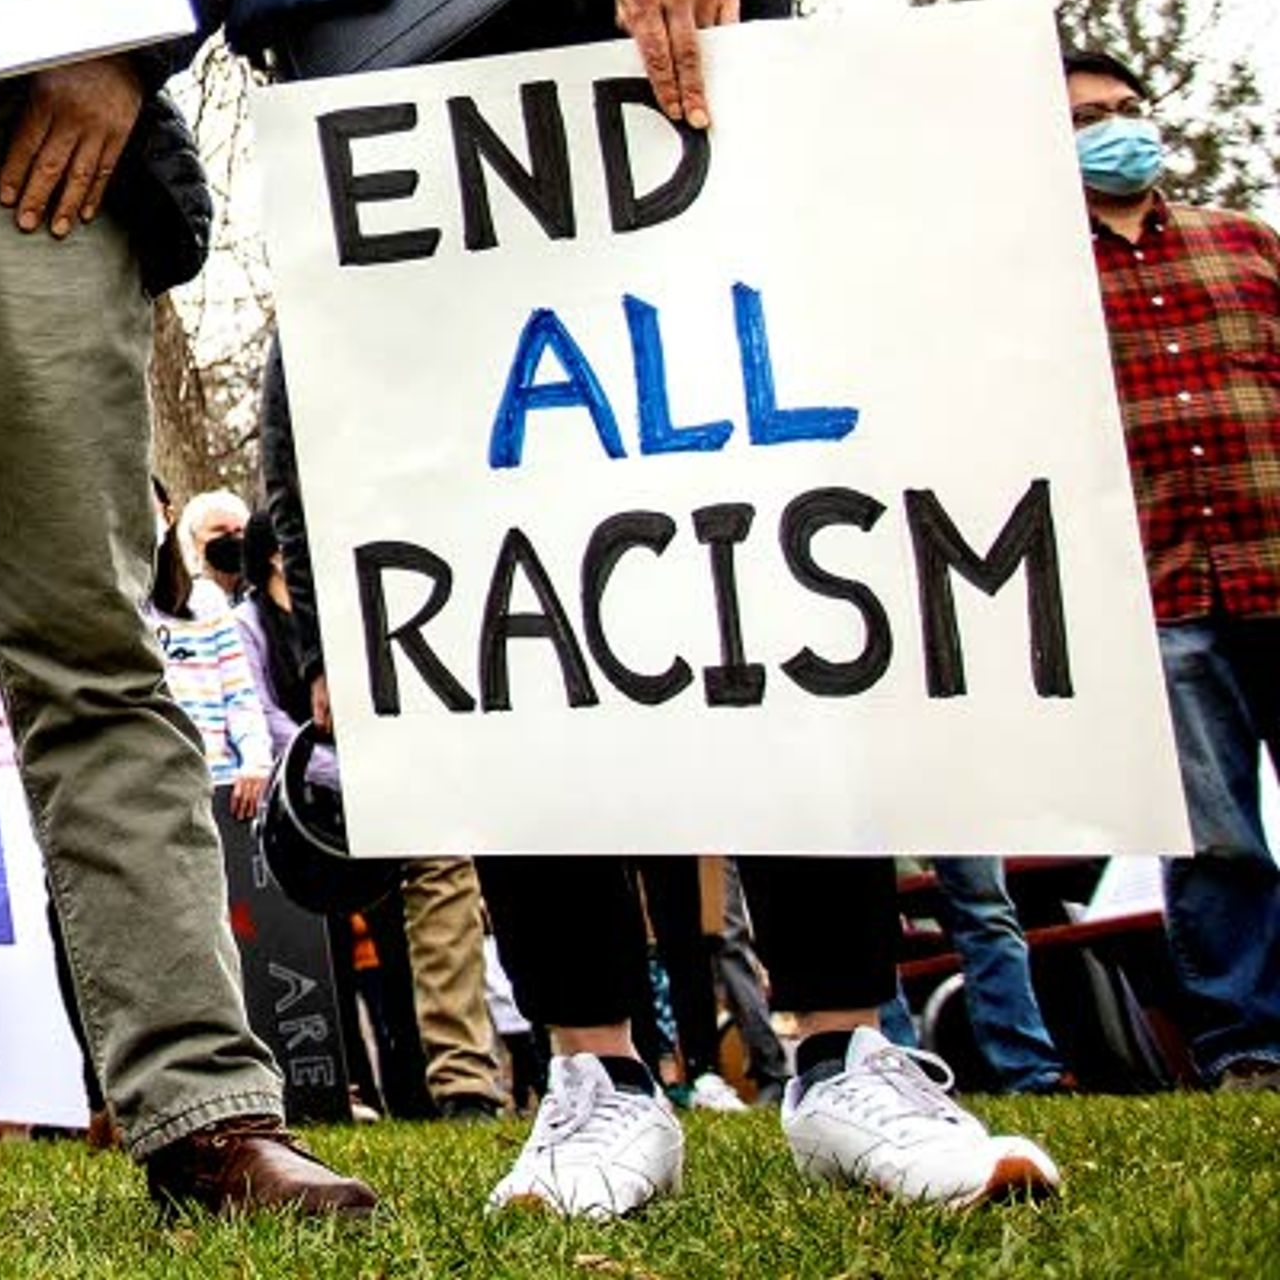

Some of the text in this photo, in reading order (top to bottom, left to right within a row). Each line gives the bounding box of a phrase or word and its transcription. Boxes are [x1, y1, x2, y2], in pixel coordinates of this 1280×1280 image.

[317, 76, 712, 266] END
[488, 280, 861, 470] ALL
[354, 478, 1075, 716] RACISM
